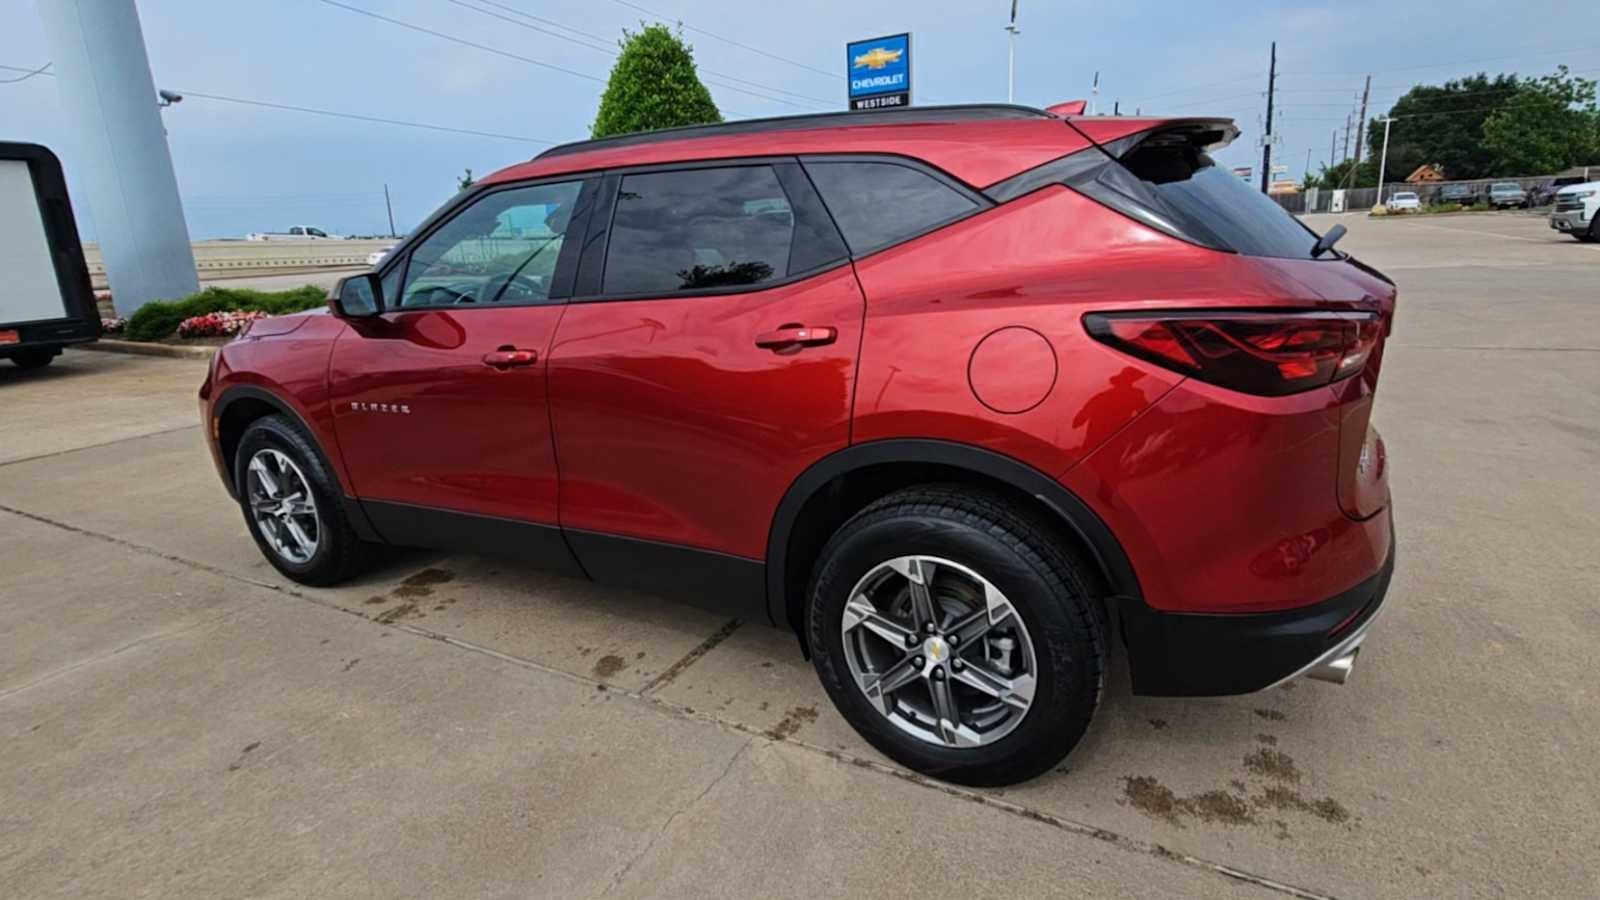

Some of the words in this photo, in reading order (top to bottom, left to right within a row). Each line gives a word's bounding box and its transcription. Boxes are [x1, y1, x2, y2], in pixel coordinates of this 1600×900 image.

[852, 74, 904, 89] CHEVROLET
[856, 96, 901, 108] WESTSIDE
[350, 402, 410, 414] BLAZER
